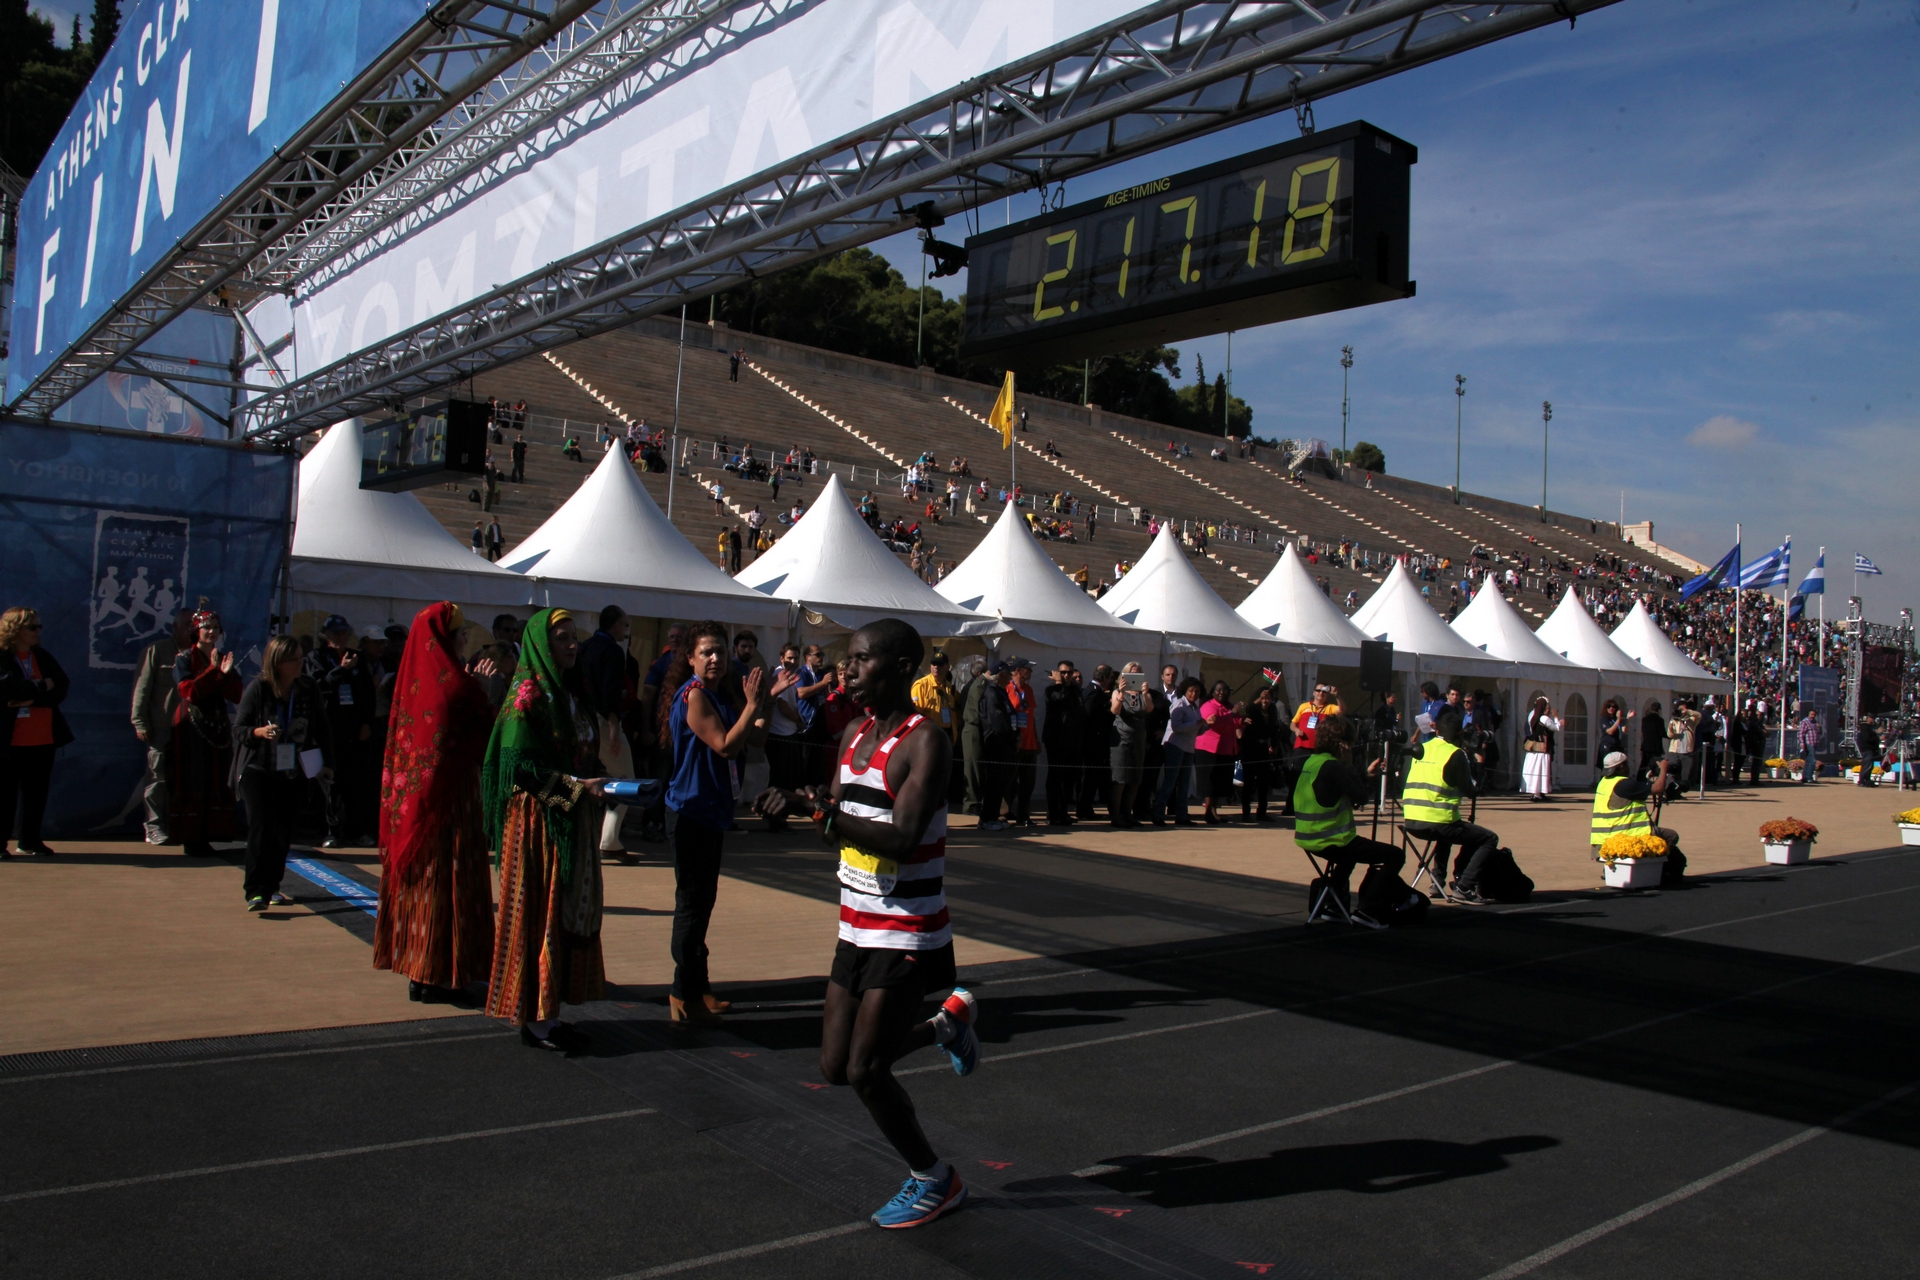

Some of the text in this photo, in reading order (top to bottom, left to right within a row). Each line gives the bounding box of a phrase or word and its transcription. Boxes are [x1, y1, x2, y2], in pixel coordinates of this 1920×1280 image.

[45, 66, 124, 221] ATHENS
[1104, 177, 1170, 208] ALGE-TIMING
[111, 527, 176, 539] ATHENS
[110, 538, 175, 549] CLASSIC
[109, 549, 174, 561] MARATHON
